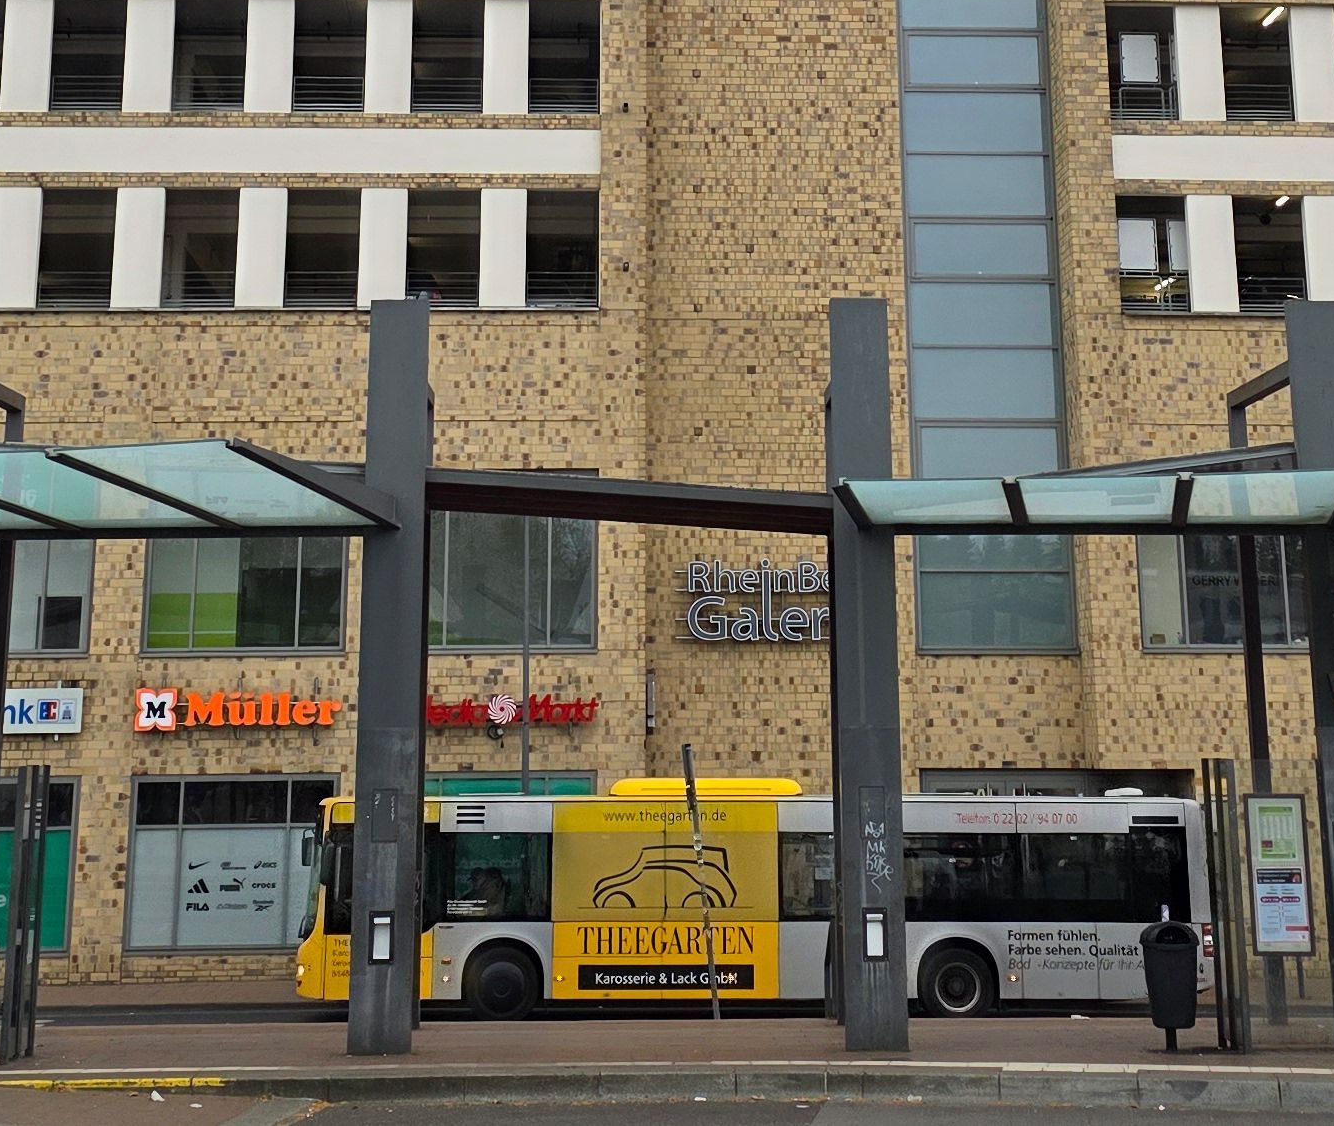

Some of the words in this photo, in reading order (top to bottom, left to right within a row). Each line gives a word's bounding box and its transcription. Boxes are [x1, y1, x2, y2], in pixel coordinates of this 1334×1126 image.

[1192, 575, 1231, 587] GERRY
[185, 692, 343, 726] Müller
[603, 809, 727, 825] www.theegartn.de
[1052, 814, 1064, 824] 07
[1066, 813, 1078, 824] 00
[186, 903, 209, 911] FILA
[577, 926, 754, 955] THEEGARTEN
[1008, 930, 1054, 941] Formen
[1058, 930, 1101, 941] fühlen.
[1008, 944, 1042, 955] Farbe
[1045, 944, 1086, 955] sehen.
[1089, 944, 1139, 957] Qualität
[1098, 958, 1115, 971] für
[595, 972, 656, 985] Karosserie
[659, 972, 668, 985] &
[671, 972, 697, 985] Lack
